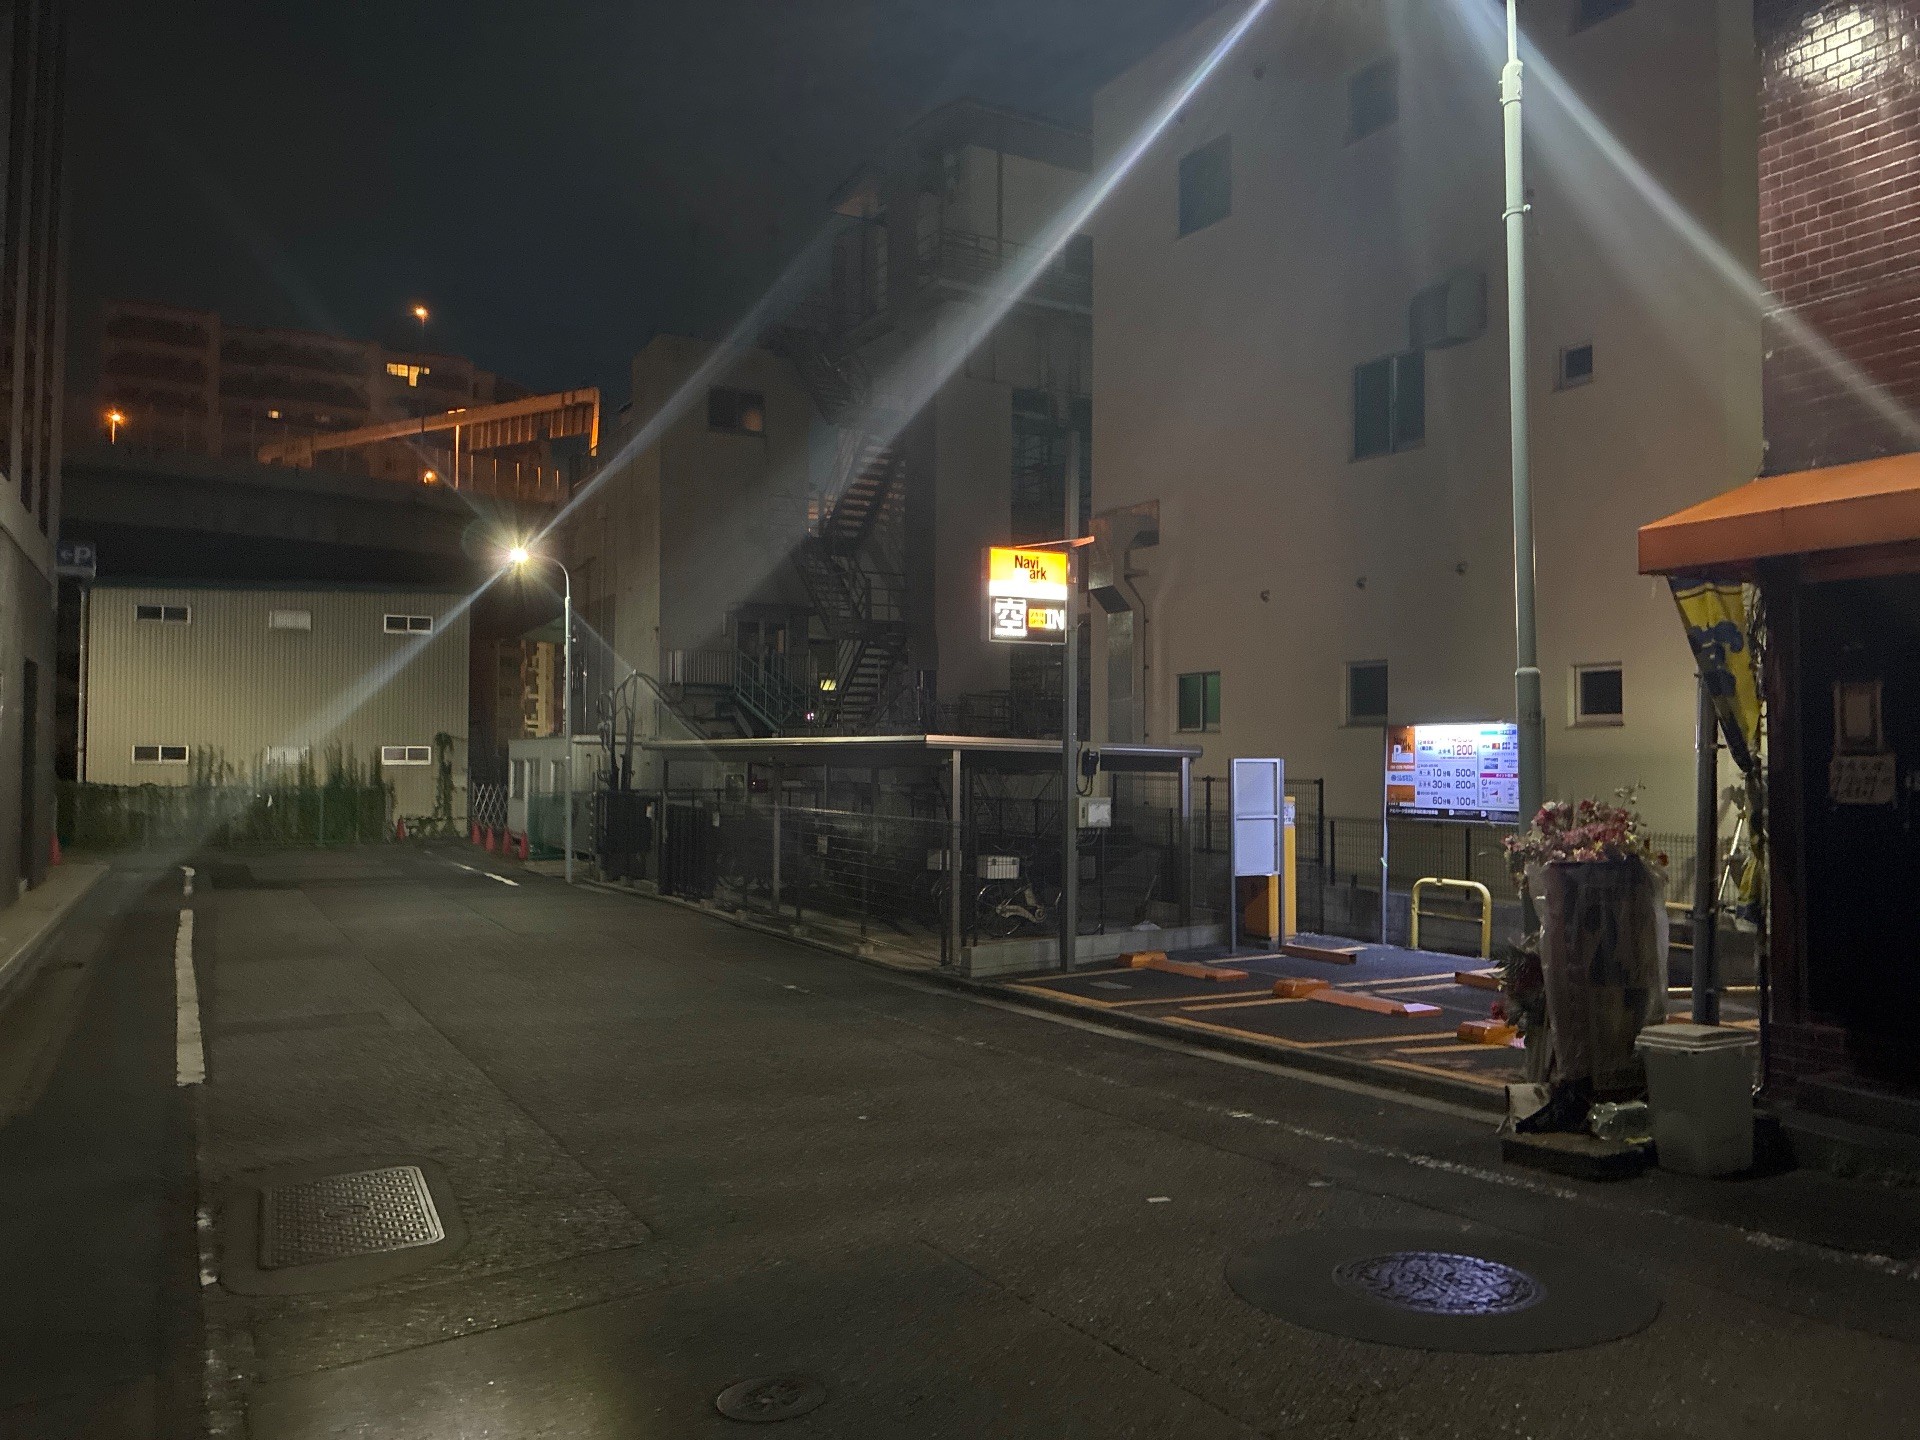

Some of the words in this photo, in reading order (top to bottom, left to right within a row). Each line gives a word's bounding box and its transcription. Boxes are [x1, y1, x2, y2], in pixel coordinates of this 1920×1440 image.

[1014, 554, 1039, 570] Navi
[994, 597, 1028, 637] 空
[1045, 608, 1065, 630] IN
